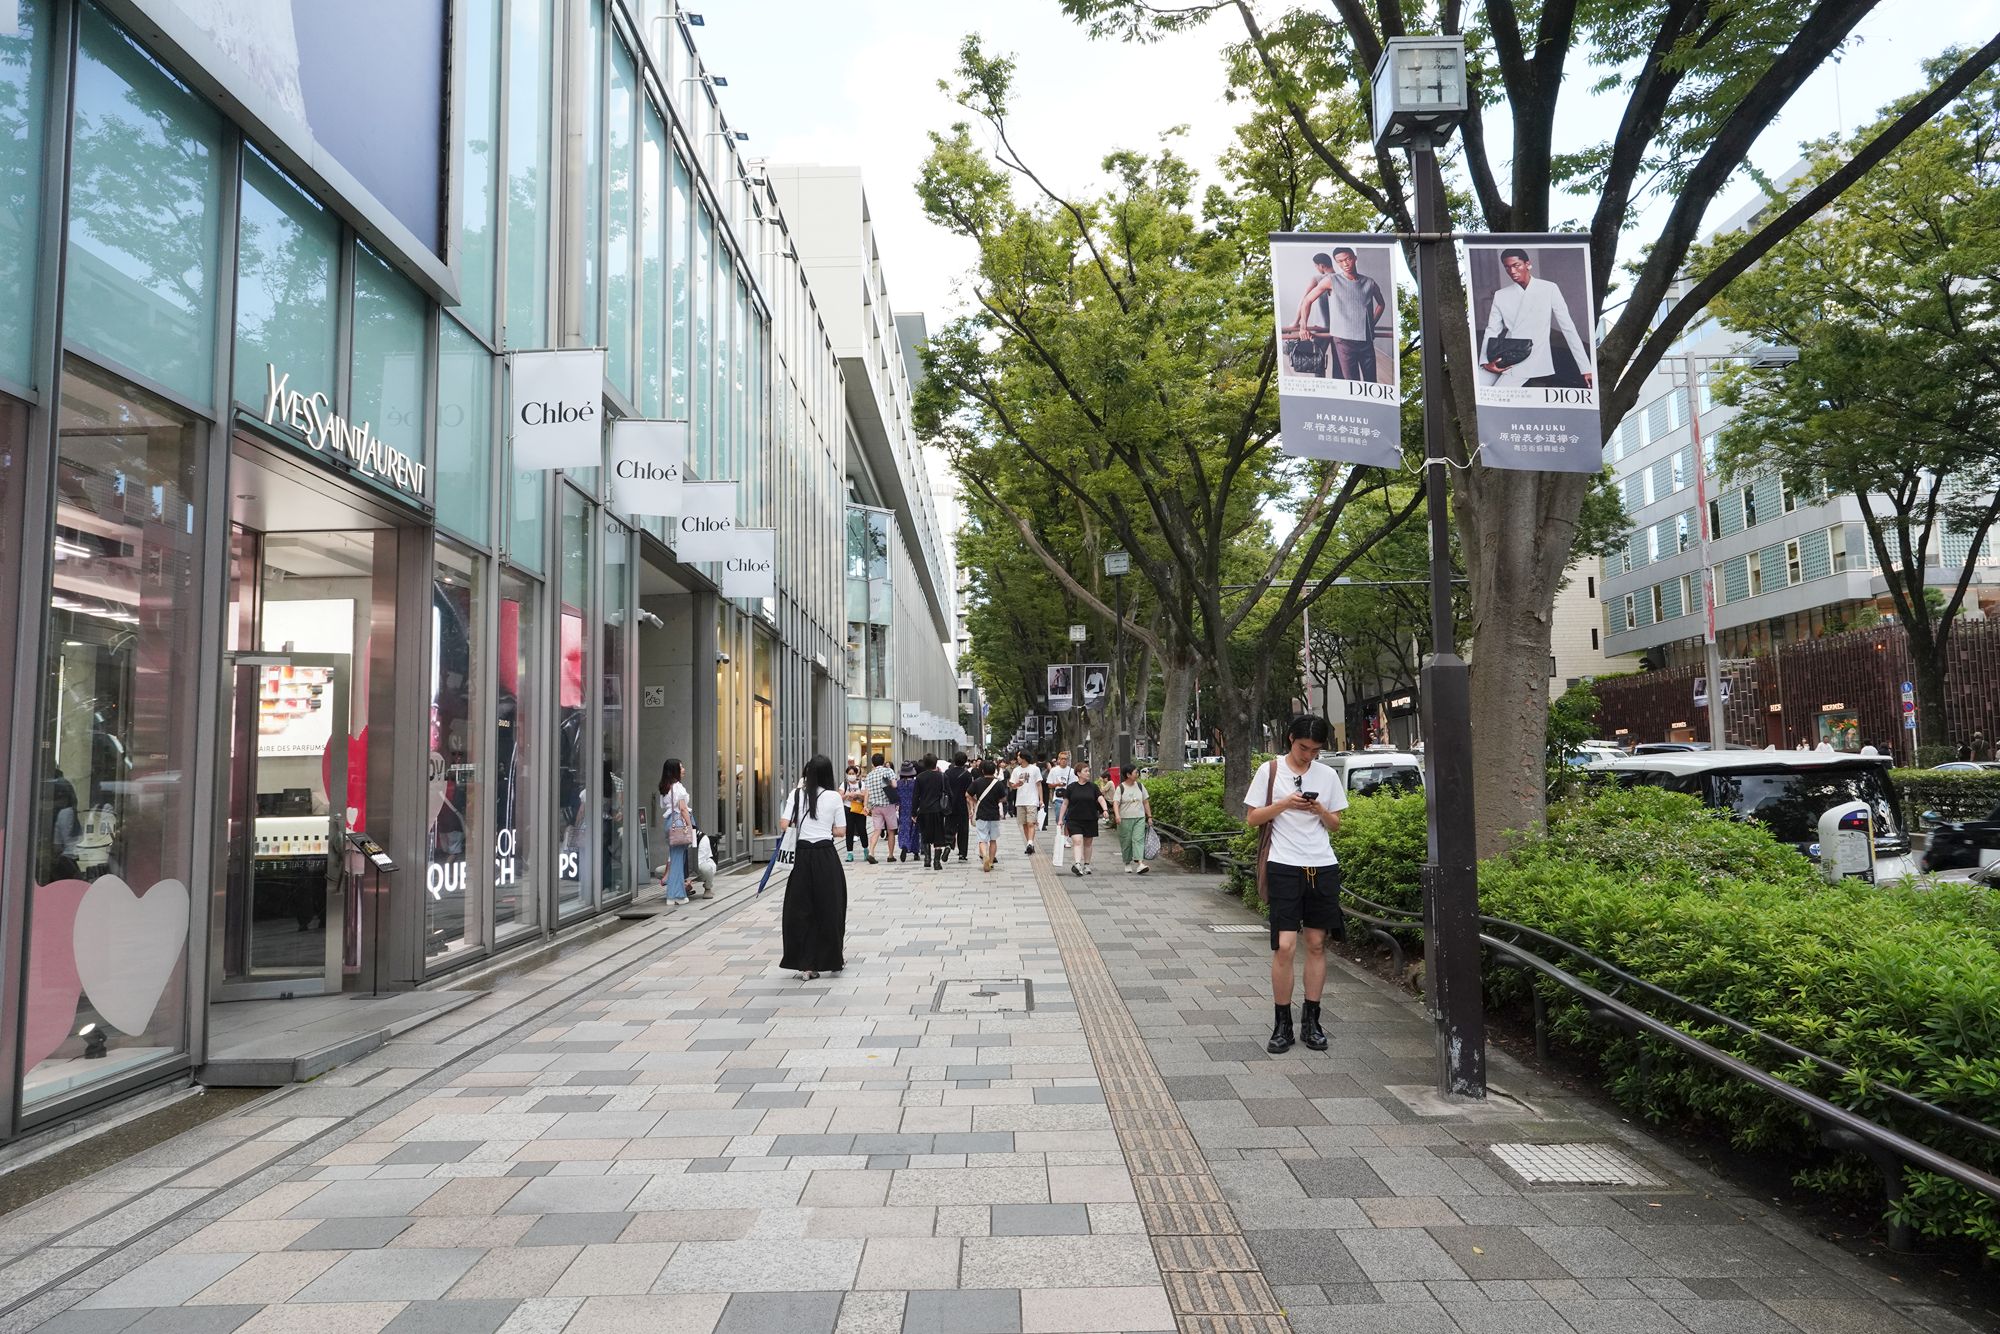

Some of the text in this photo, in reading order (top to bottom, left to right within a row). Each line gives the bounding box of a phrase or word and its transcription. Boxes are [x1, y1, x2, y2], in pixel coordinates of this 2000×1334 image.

[1349, 381, 1395, 401] DIOR
[1544, 388, 1593, 405] DIOR
[521, 400, 594, 427] Chloé
[1316, 413, 1369, 425] HARAJUKU
[1511, 423, 1566, 432] HARAJUKU
[616, 459, 677, 481] Chloé
[681, 515, 731, 534] Chloé
[726, 557, 770, 574] Chloé
[292, 744, 326, 752] PARFUMS
